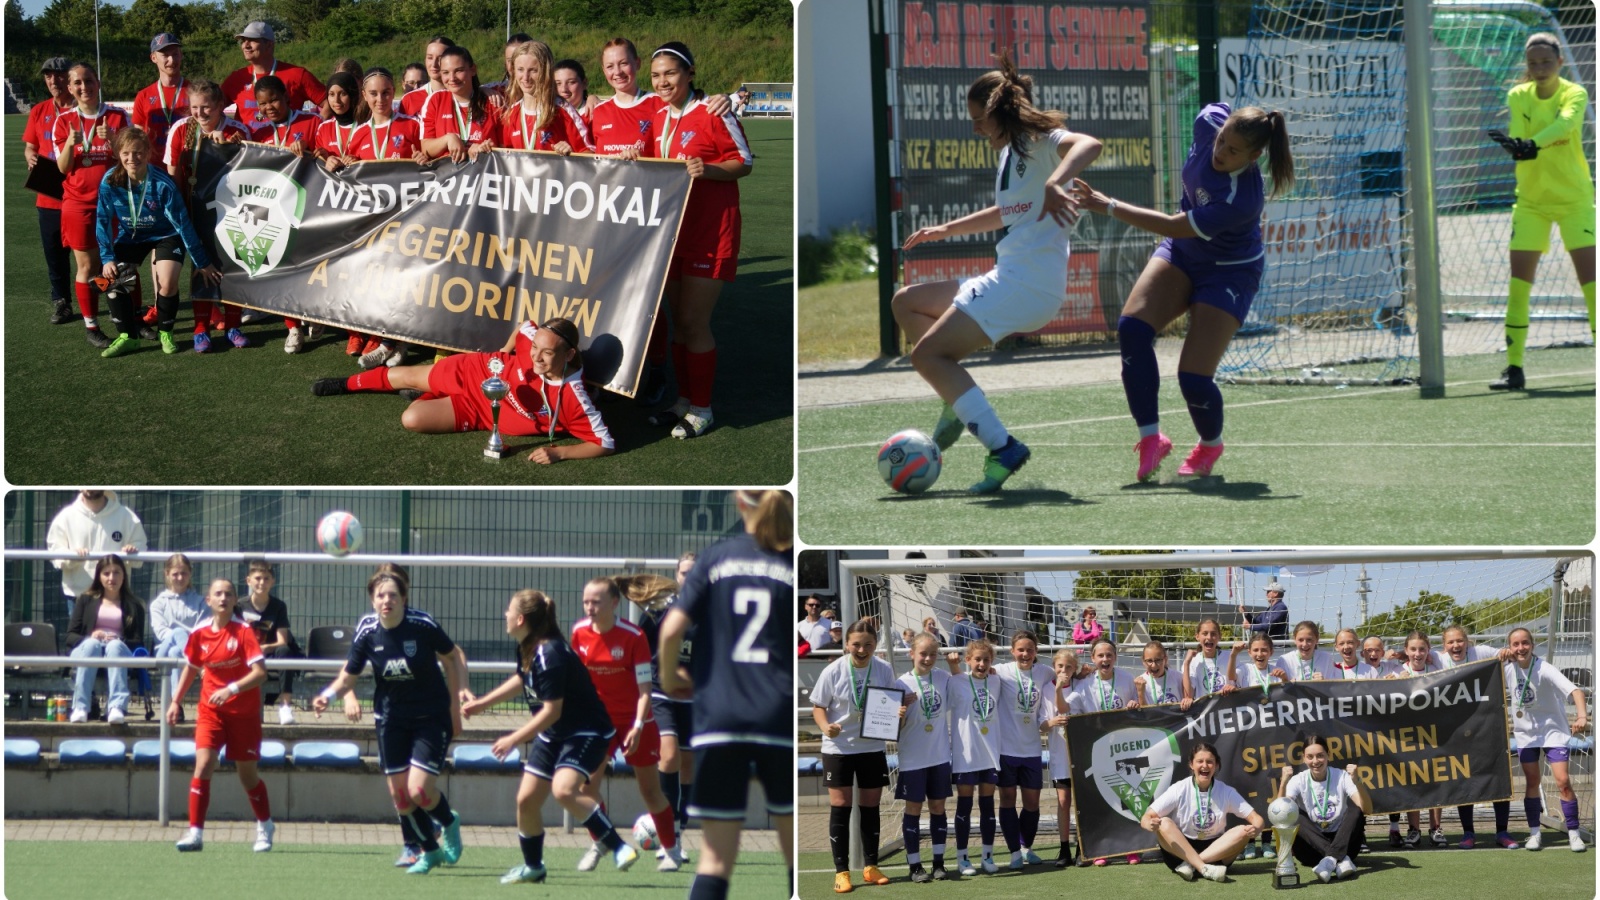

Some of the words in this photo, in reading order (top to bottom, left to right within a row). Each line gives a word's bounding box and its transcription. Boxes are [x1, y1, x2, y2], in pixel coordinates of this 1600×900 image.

[964, 4, 1046, 69] REIFEN
[1049, 6, 1149, 71] SERVICE
[1225, 52, 1300, 99] SPORT
[1307, 45, 1396, 98] HÖLZEL
[903, 84, 940, 121] NEUE
[1103, 86, 1149, 120] FELGEN
[905, 139, 932, 170] KFZ
[238, 183, 278, 200] JUGEND
[353, 221, 594, 285] IEGERINNEN
[307, 258, 330, 288] A
[732, 588, 771, 663] 2
[382, 658, 412, 677] AXA
[1186, 678, 1490, 740] NIEDERRHEINPOKAL
[1109, 739, 1151, 758] JUGEND
[1242, 724, 1439, 773] SIEGRINNEN
